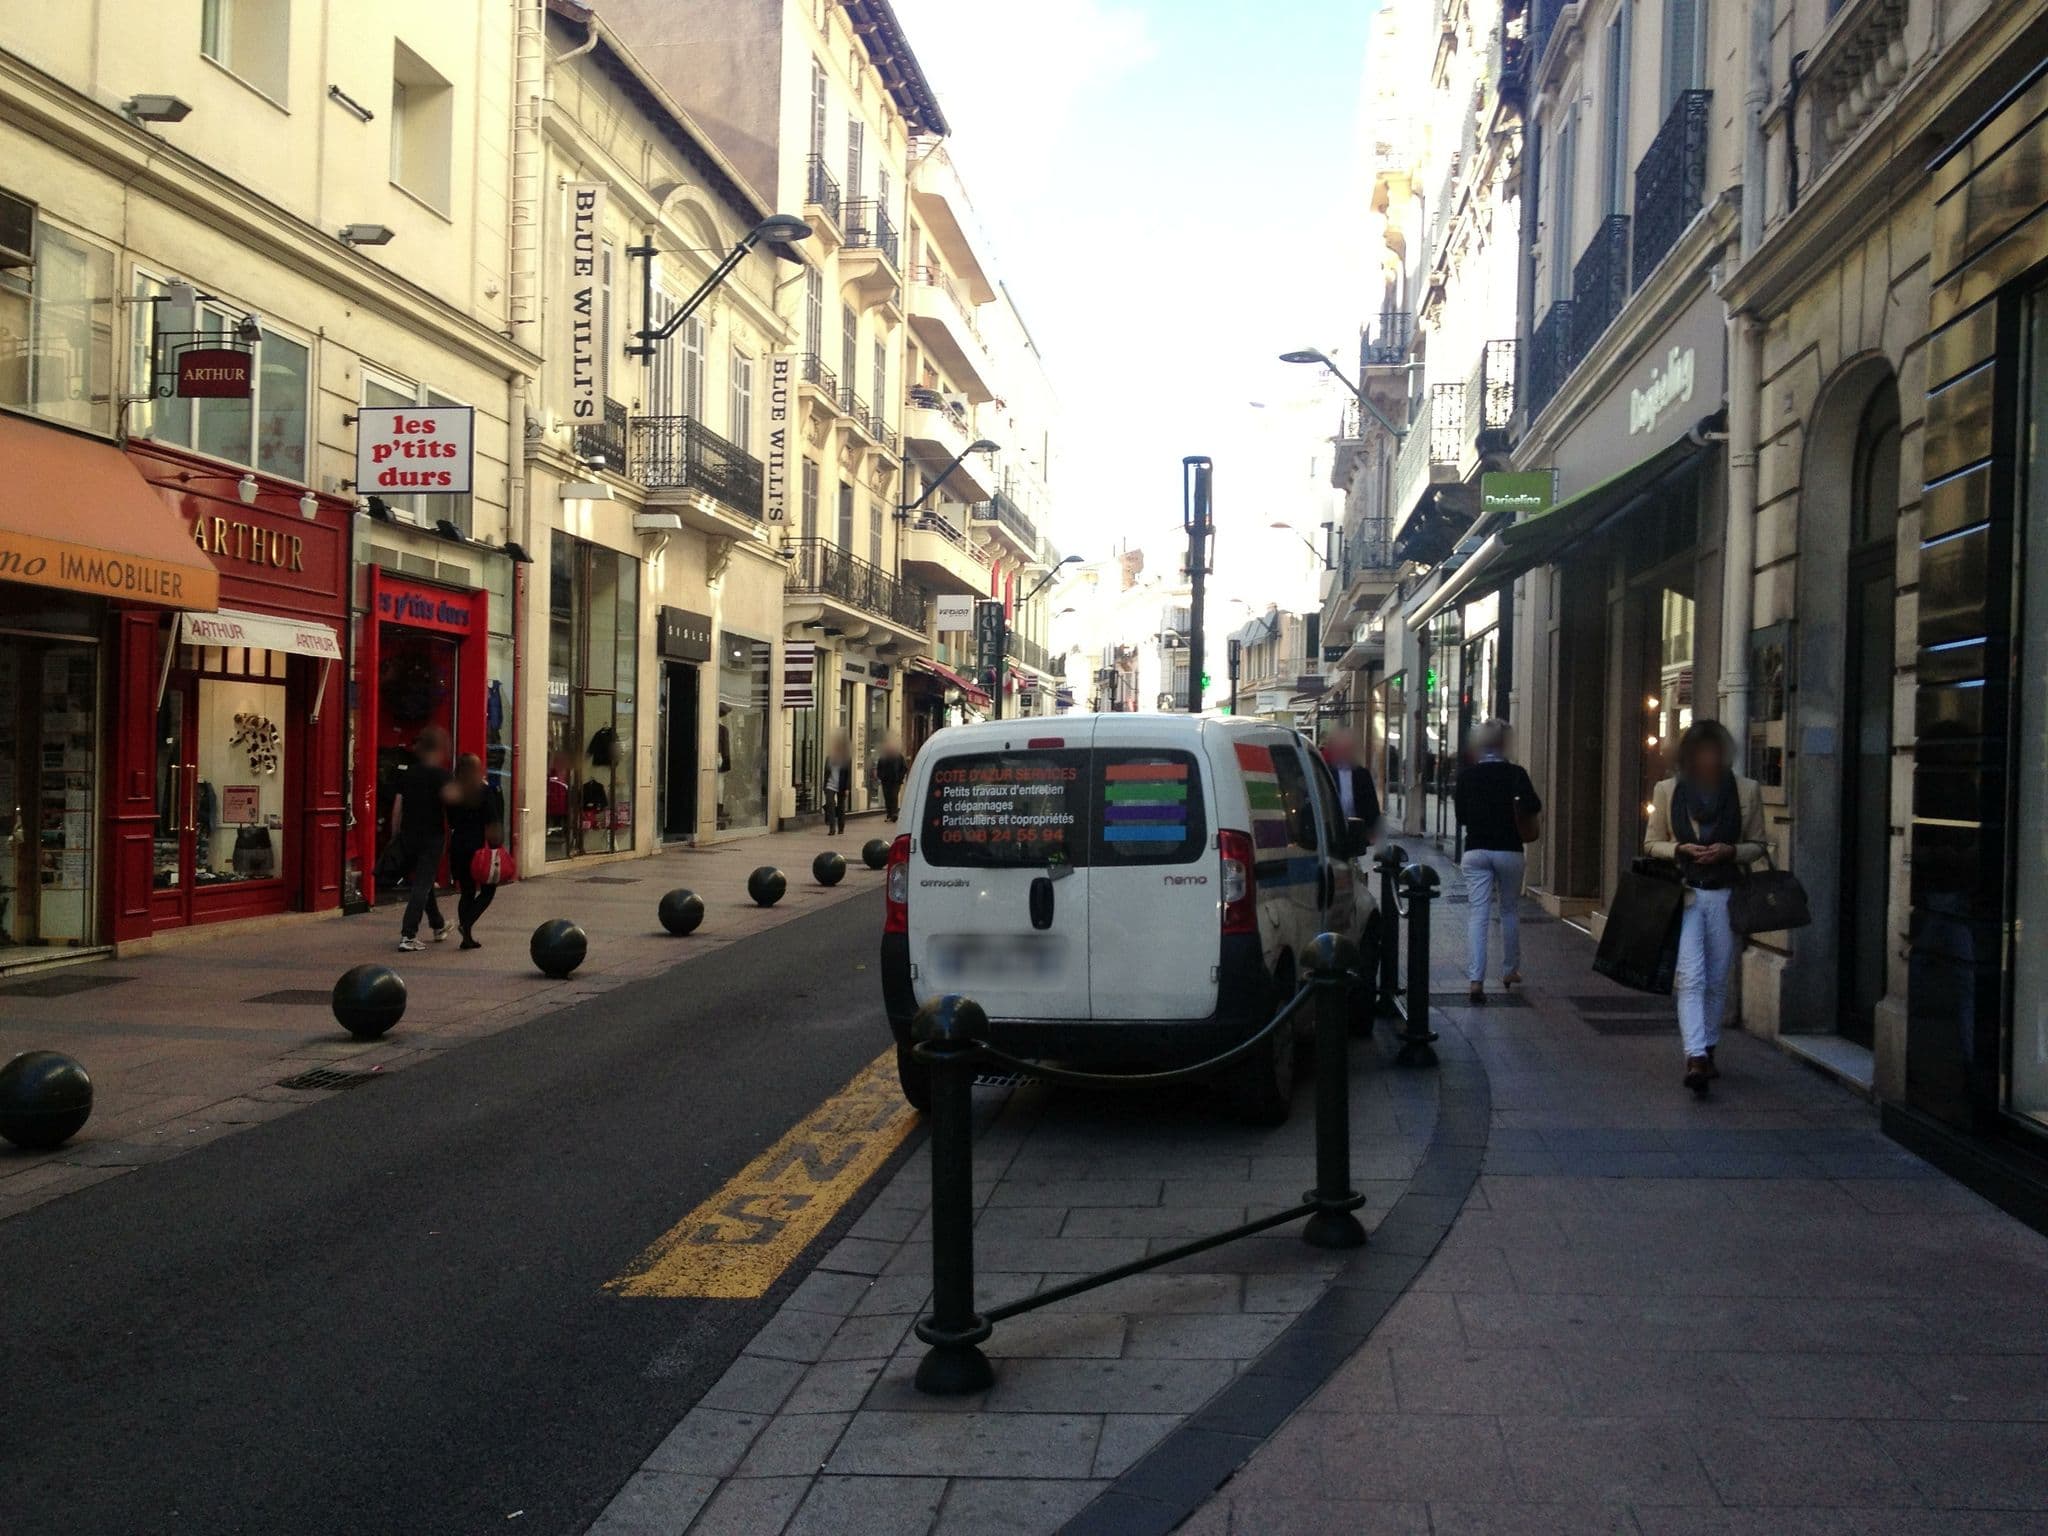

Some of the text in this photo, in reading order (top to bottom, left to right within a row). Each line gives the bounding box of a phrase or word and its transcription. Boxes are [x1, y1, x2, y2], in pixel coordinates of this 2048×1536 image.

[573, 189, 596, 419] BLUE WILLI'S
[183, 367, 246, 381] ARTHUR
[392, 415, 437, 435] les
[372, 438, 458, 464] p'tits
[767, 359, 788, 522] BLUE WILLI'S
[377, 466, 453, 487] durs
[193, 516, 305, 573] ARTHUR
[59, 551, 184, 599] IMMOBILIER
[191, 618, 246, 640] ARTHUR
[668, 625, 710, 643] SISLEY
[295, 632, 336, 653] ARTHUR
[1015, 767, 1078, 781] SERVICES
[943, 784, 1065, 798] Petits travaux d'entretien
[942, 800, 1014, 813] et dépannages
[942, 813, 1075, 827] Particuliers et copropriétés
